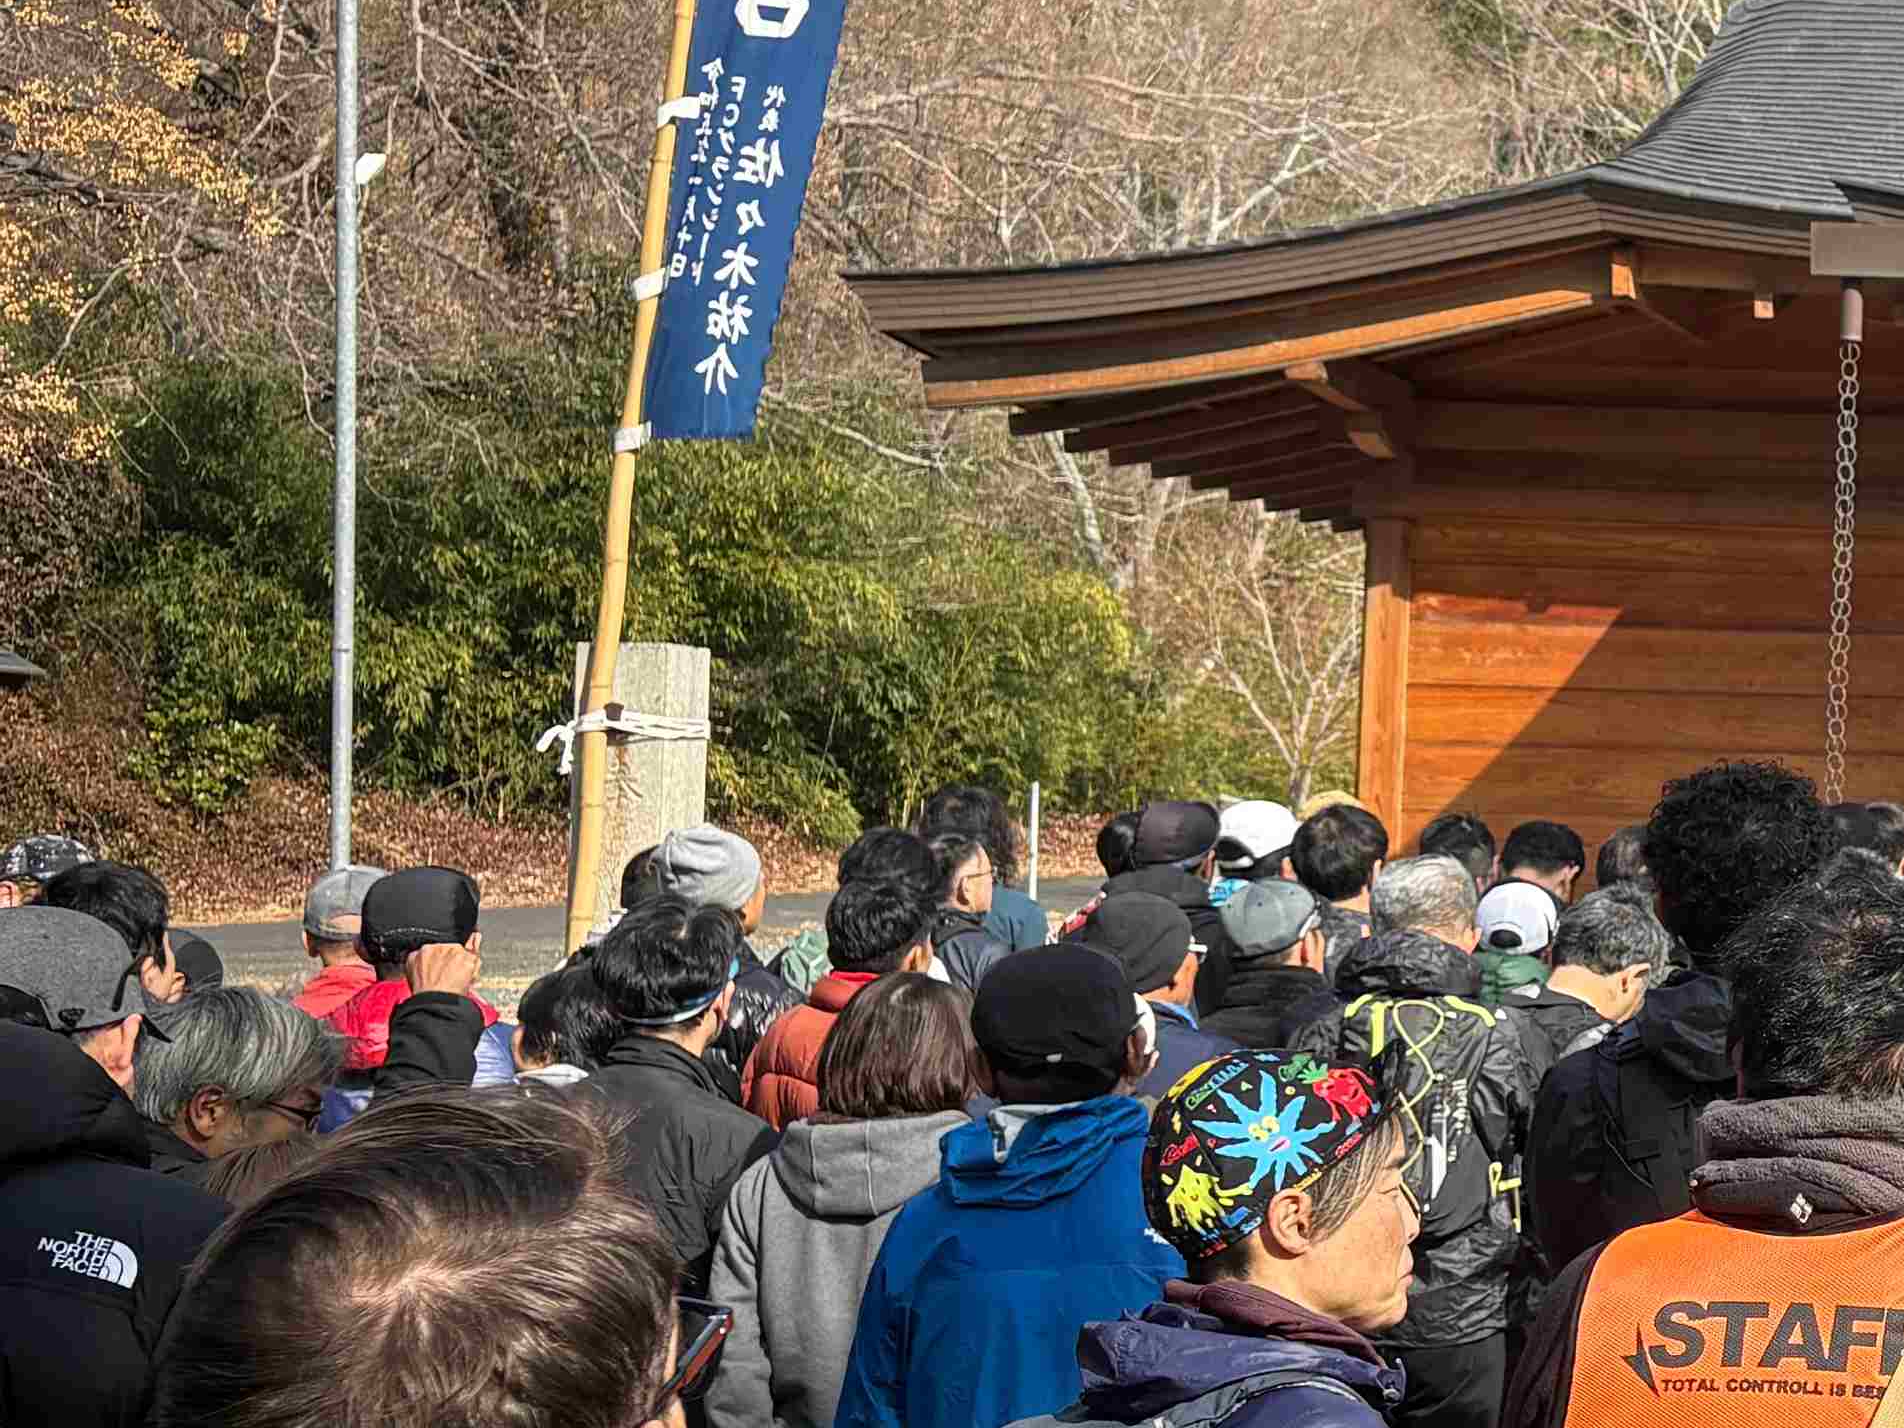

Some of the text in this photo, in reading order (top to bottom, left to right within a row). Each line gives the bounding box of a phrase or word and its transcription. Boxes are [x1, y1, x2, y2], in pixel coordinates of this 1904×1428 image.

[37, 1237, 107, 1266] NORTH
[75, 1231, 112, 1251] THE
[51, 1254, 101, 1277] FACE
[1661, 1378, 1719, 1392] TOTAL
[1726, 1379, 1823, 1395] CONTROLL
[1830, 1384, 1846, 1397] IS
